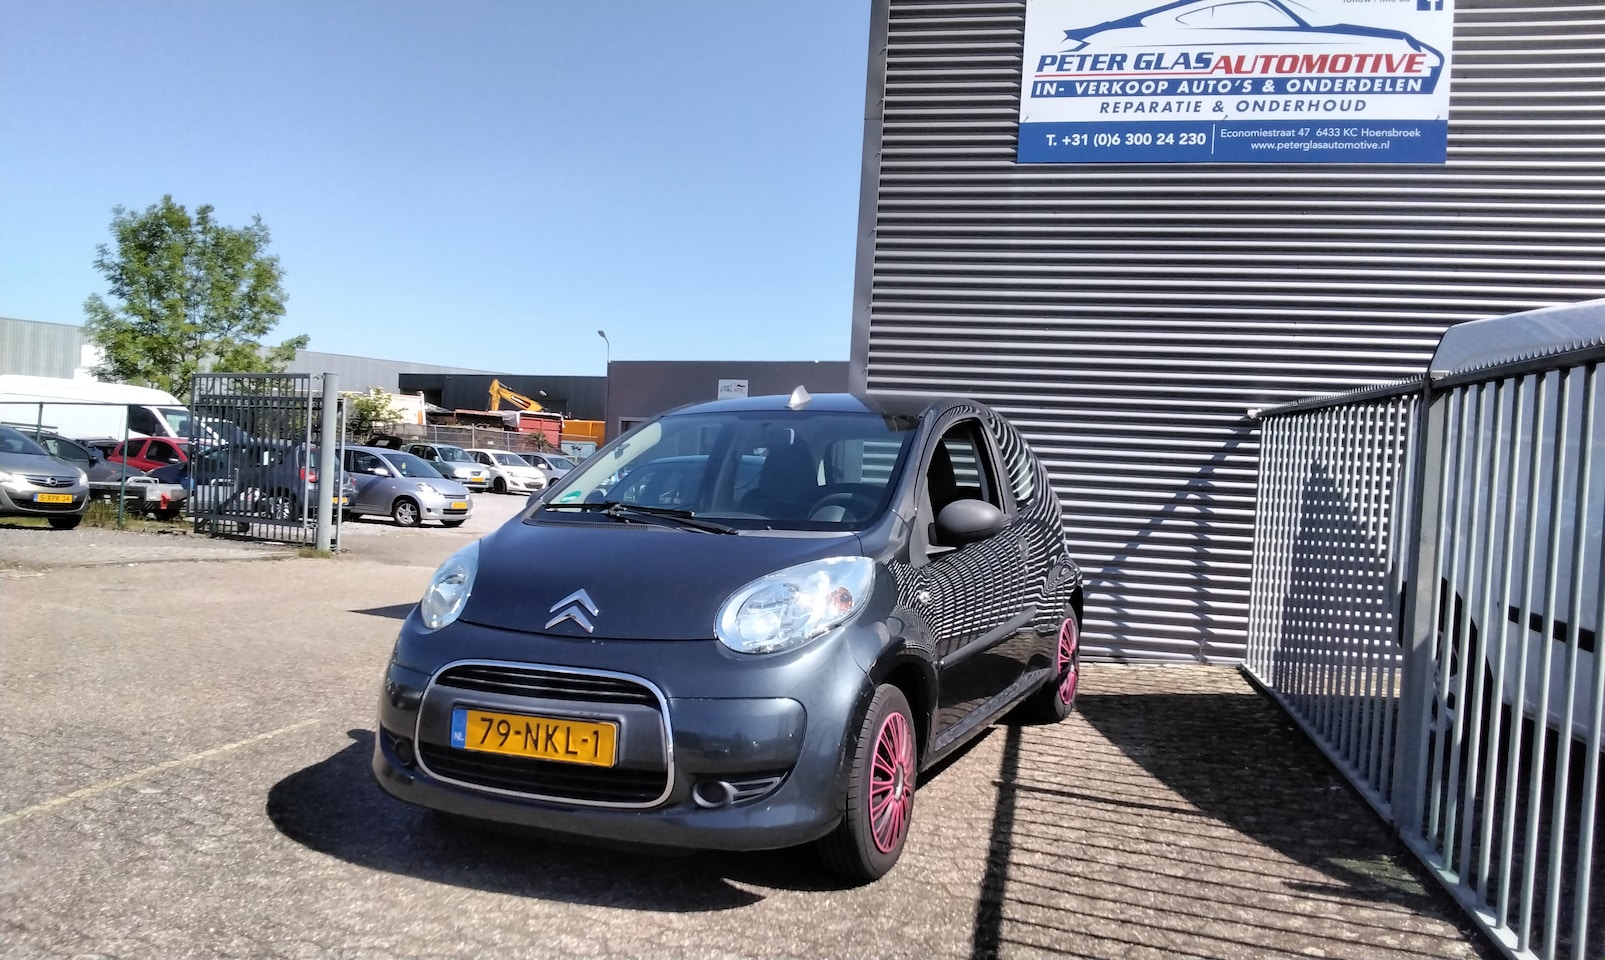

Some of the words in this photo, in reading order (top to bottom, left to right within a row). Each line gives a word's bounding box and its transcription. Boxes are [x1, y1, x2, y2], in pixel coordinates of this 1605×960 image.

[1036, 54, 1128, 72] PETER
[1133, 52, 1214, 71] GLAS
[1210, 53, 1427, 74] AUTOMOTIVE
[1035, 81, 1065, 96] IN-
[1075, 80, 1169, 95] VERKOOP
[1177, 79, 1253, 94] AUTO'S
[1262, 79, 1276, 93] &
[1286, 78, 1422, 93] ONDERDELEN
[1100, 100, 1203, 114] REPARATIE
[1212, 100, 1225, 113] &
[1235, 99, 1367, 113] ONDERHOUD
[1046, 134, 1058, 146] T.
[1062, 133, 1088, 146] +31
[1093, 132, 1121, 147] (0)6
[1125, 132, 1151, 146] 300
[1156, 132, 1175, 146] 24
[1178, 131, 1207, 145] 230
[1220, 128, 1296, 138] Economiestraat
[1298, 128, 1310, 138] 47
[1316, 127, 1341, 138] 6433
[1343, 127, 1358, 137] KC
[1361, 127, 1421, 138] Hoensbroek
[1250, 139, 1390, 151] www.peterglasautomotive.nl
[453, 731, 464, 741] NL
[480, 717, 600, 758] 79-NKL-1
